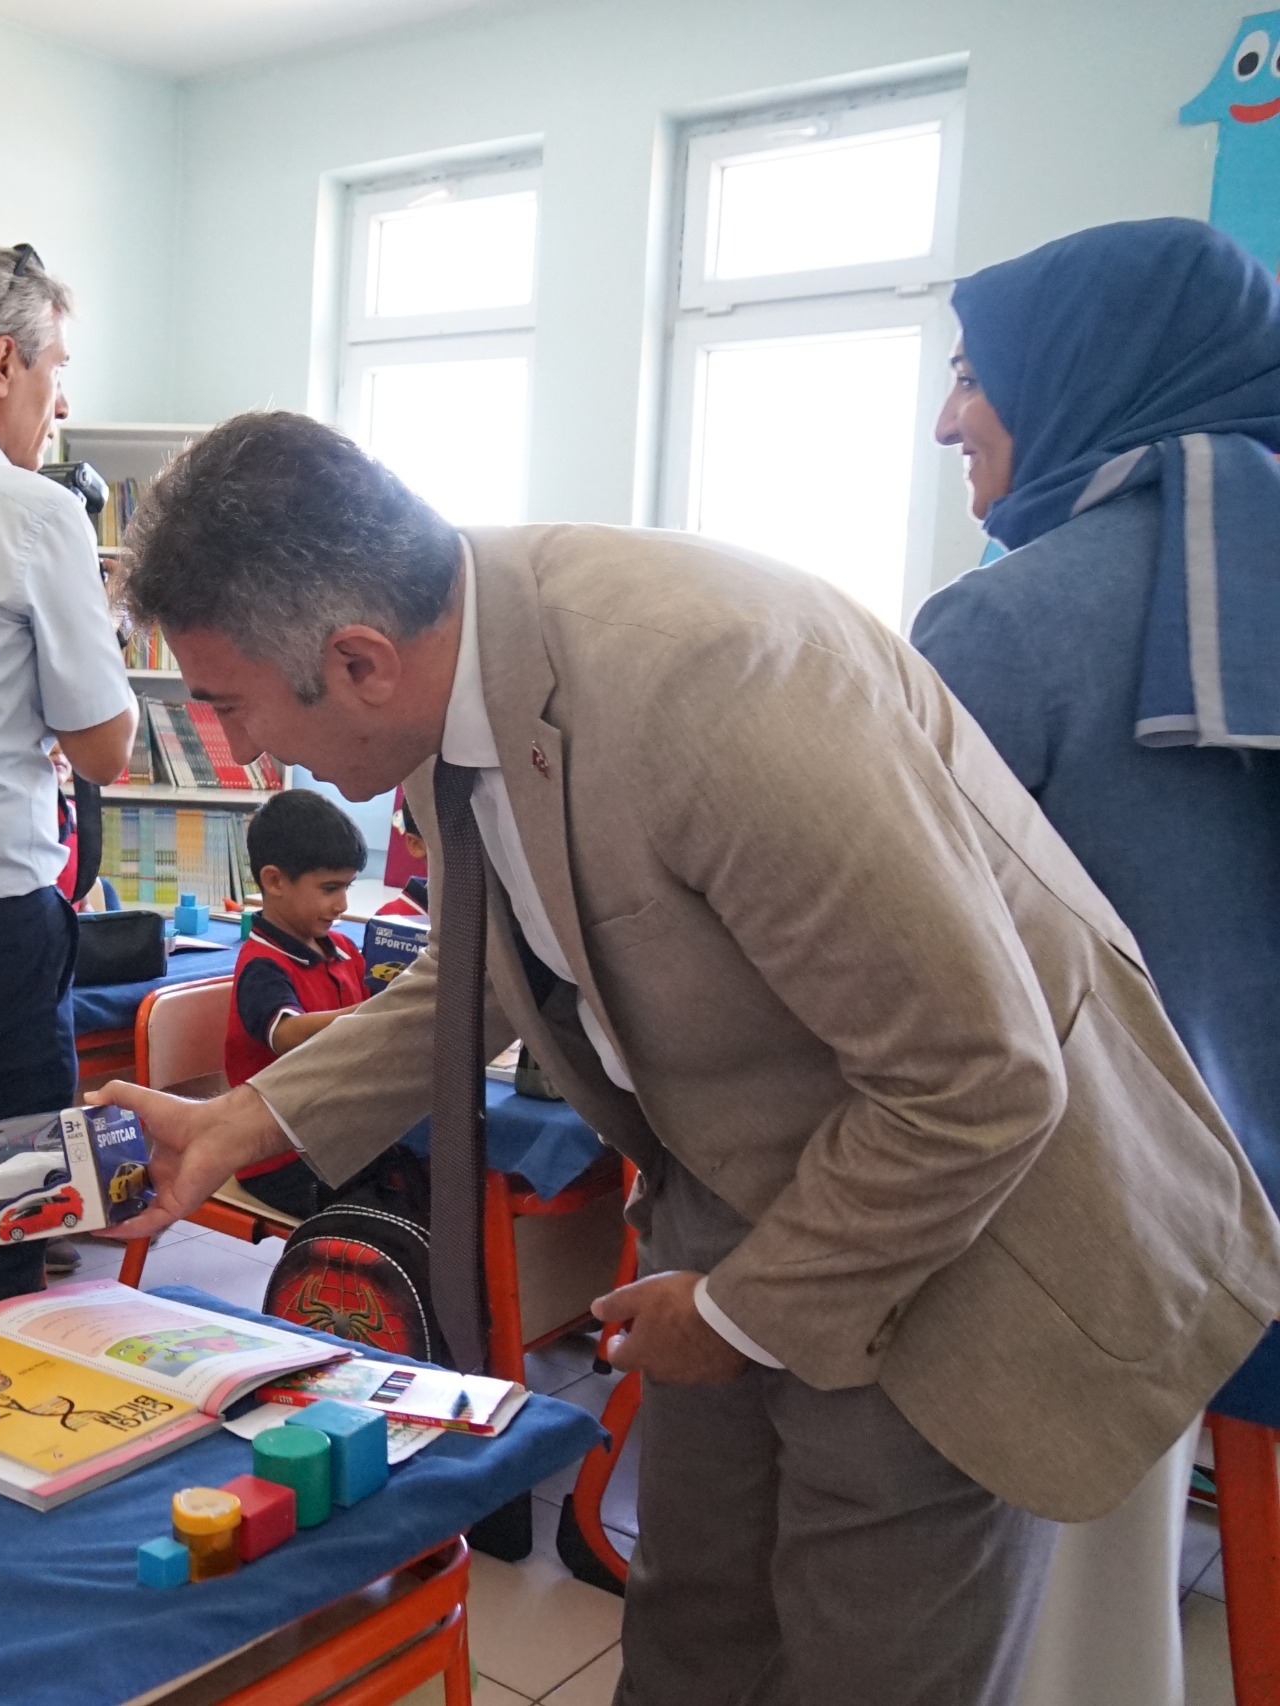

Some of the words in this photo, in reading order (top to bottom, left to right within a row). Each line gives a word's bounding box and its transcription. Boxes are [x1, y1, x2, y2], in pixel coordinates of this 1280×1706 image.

[375, 936, 420, 953] SPORTCA
[64, 1121, 81, 1133] 3+
[97, 1127, 137, 1148] SPORTCAR
